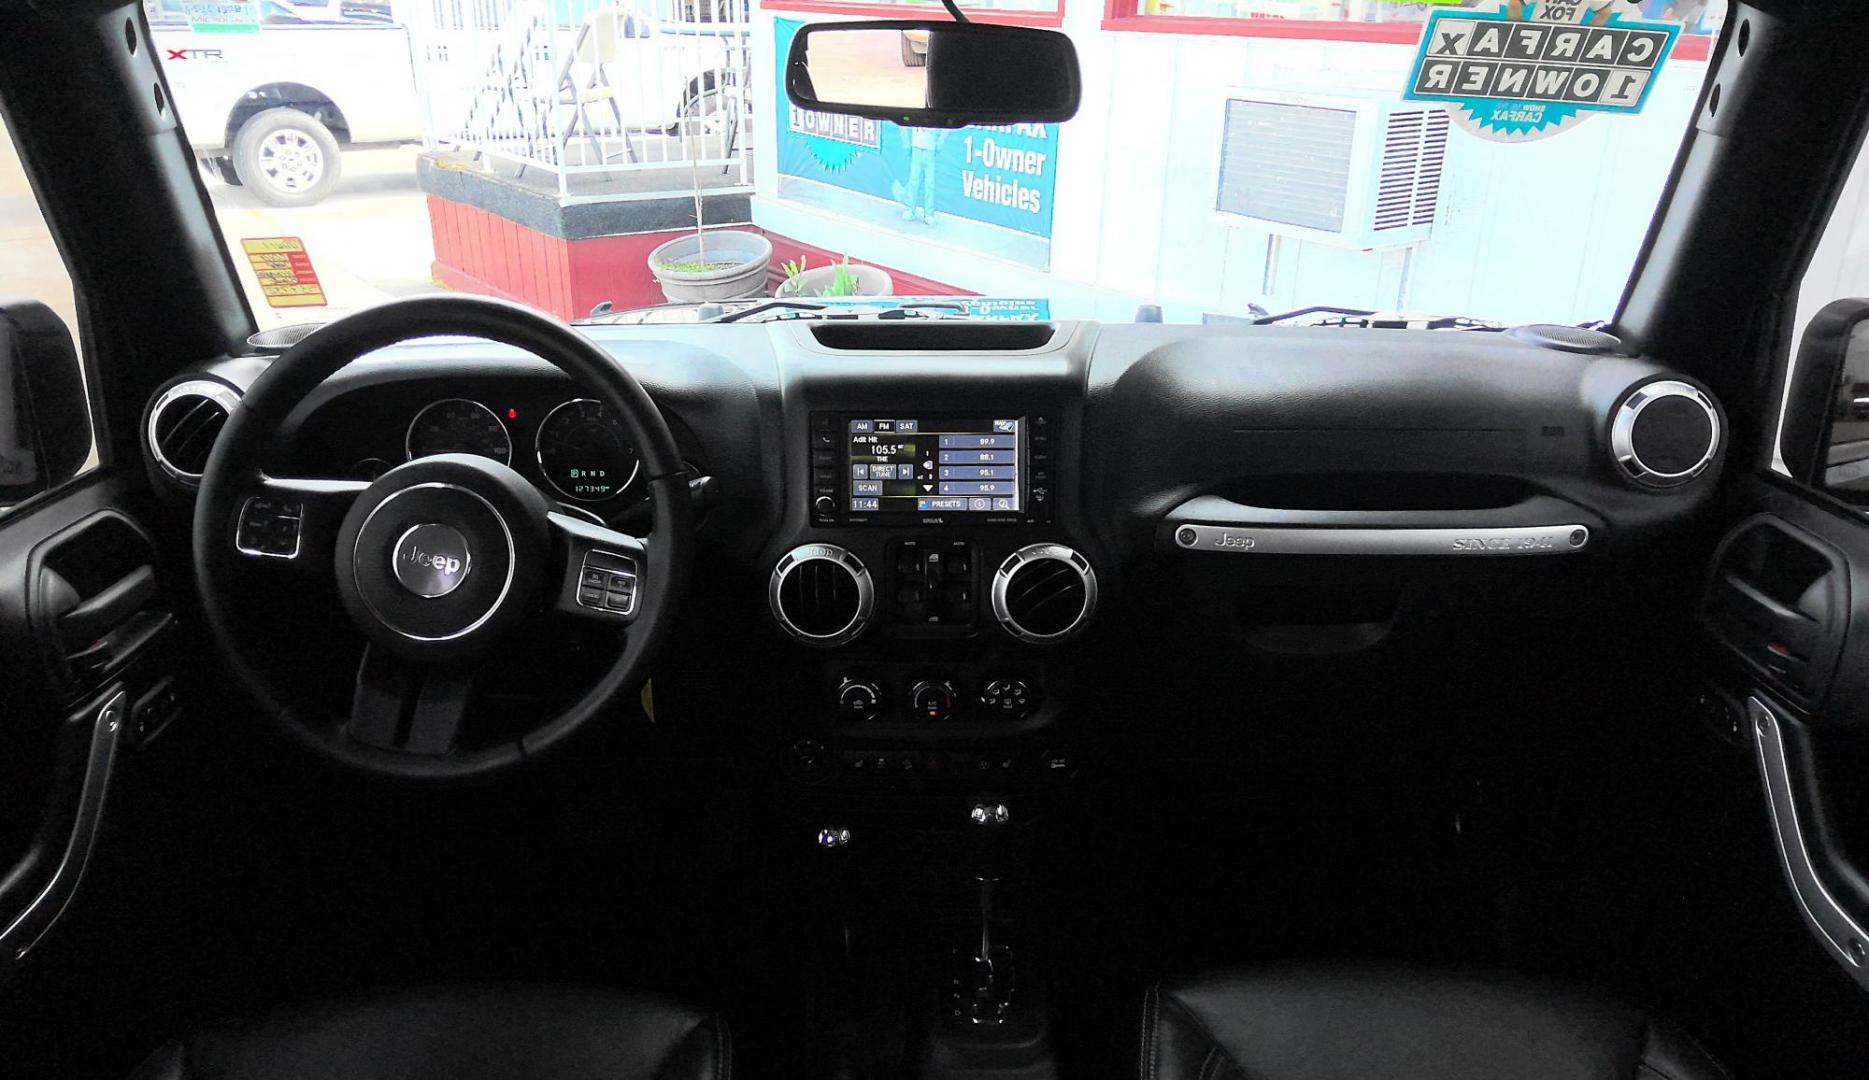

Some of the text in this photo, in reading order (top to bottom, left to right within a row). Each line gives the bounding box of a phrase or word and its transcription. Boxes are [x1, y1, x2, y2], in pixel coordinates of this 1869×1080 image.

[166, 48, 224, 60] XTR
[804, 111, 876, 142] OWNER
[964, 135, 1046, 177] 1-Owner
[962, 169, 1041, 214] Vehicles
[871, 445, 897, 455] 105.5
[858, 484, 878, 492] SCAN
[853, 500, 878, 509] 11:44
[931, 500, 961, 508] PRESETS
[1214, 532, 1255, 551] Jeep
[402, 545, 461, 576] Jeep
